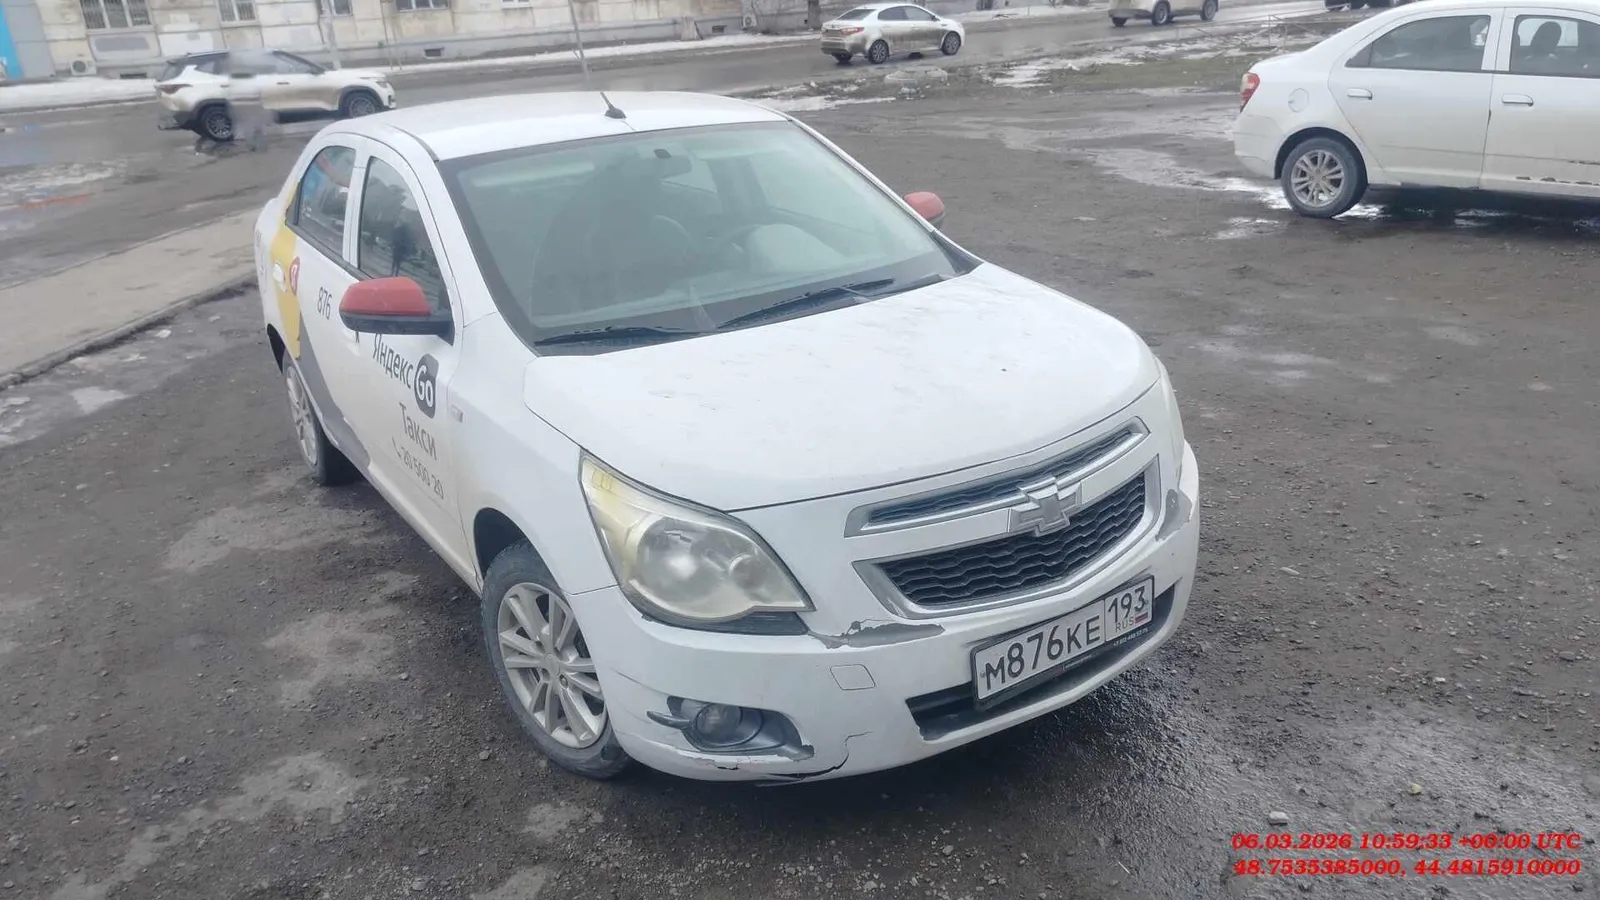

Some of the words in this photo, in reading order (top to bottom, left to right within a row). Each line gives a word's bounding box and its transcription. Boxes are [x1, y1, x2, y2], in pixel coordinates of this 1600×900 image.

[317, 286, 332, 320] 876
[373, 333, 414, 389] Яндекс
[415, 364, 434, 408] Go
[399, 401, 437, 460] Такси
[1108, 585, 1146, 623] 193
[1115, 616, 1134, 633] RUS
